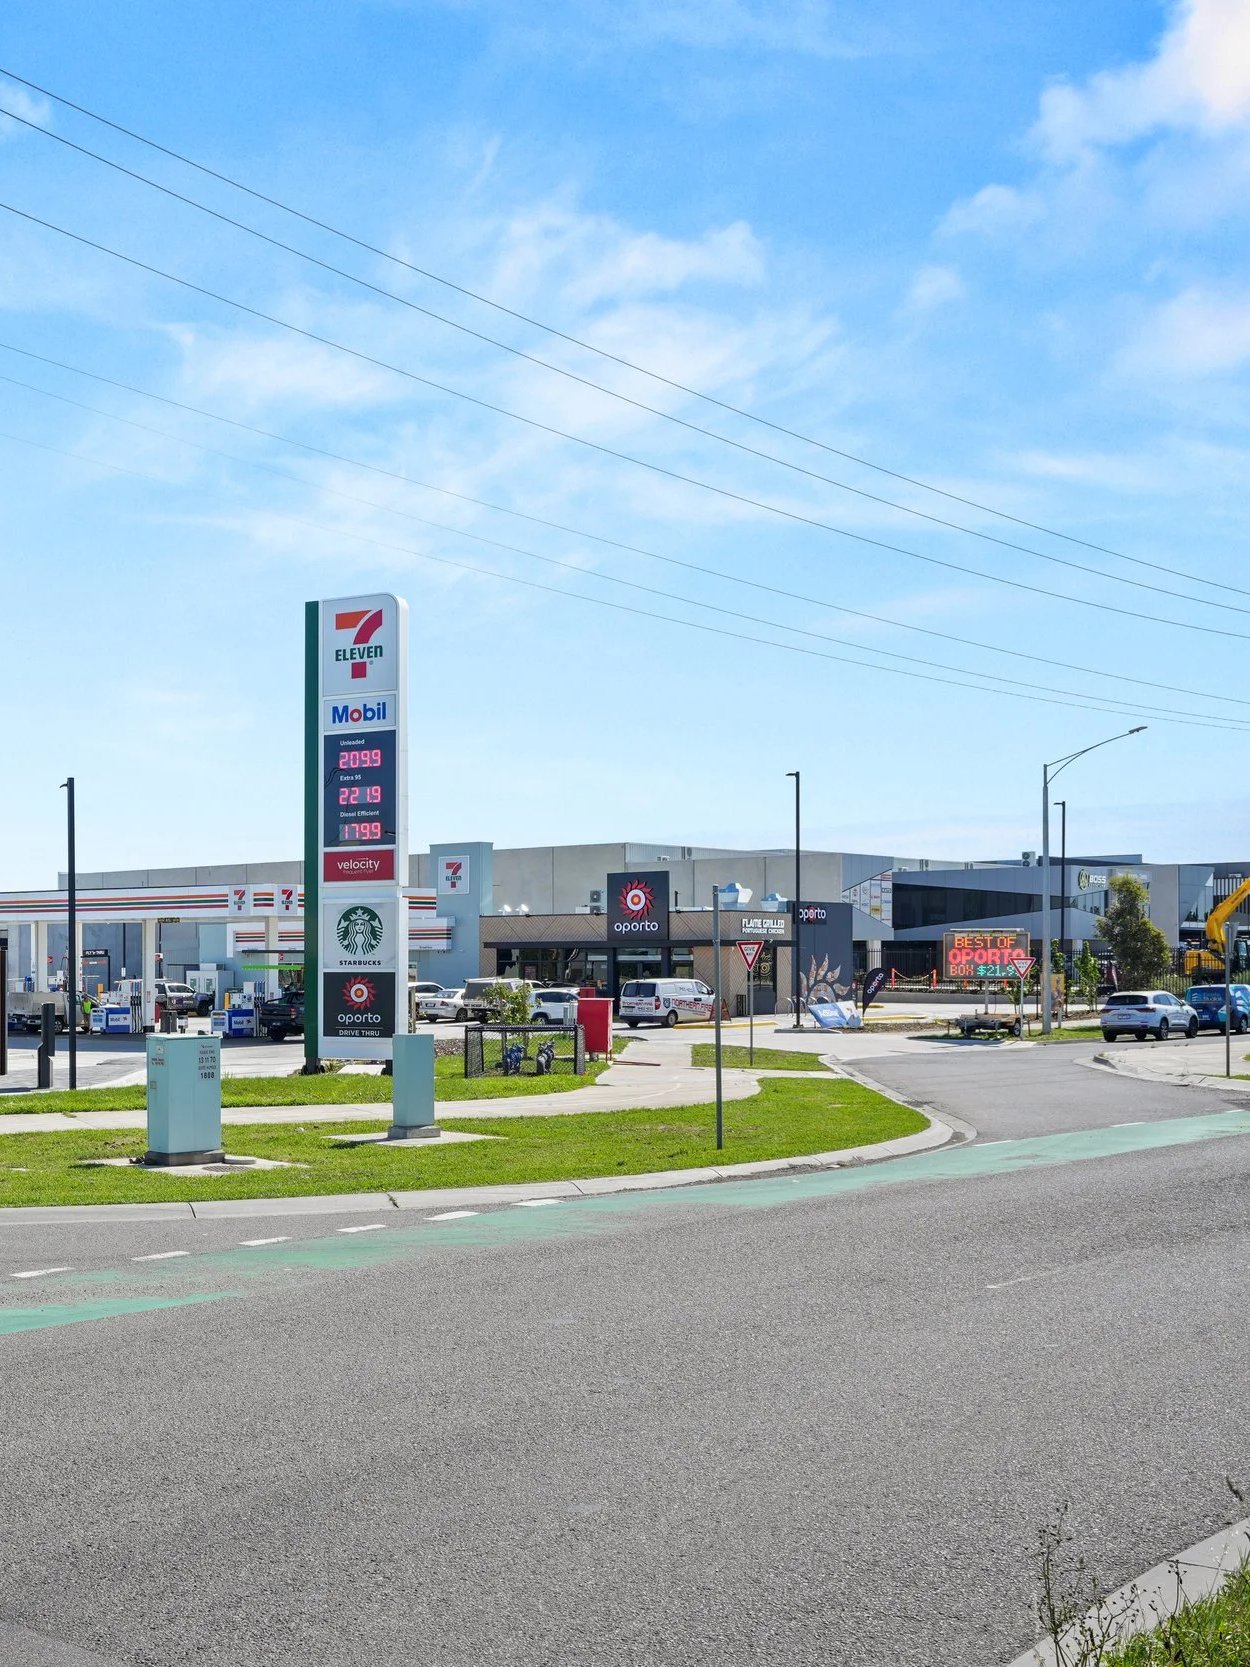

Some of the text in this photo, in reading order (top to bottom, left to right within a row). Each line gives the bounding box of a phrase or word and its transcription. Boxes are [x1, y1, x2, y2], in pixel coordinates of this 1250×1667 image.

[332, 702, 386, 724] Mobil
[339, 750, 381, 769] 209.9
[339, 786, 381, 805] 221.9
[344, 822, 381, 840] 179.9
[337, 859, 380, 871] velocity
[1089, 874, 1107, 884] BOSS
[614, 920, 659, 934] oporto
[742, 918, 785, 928] FLAME GRILLED
[954, 936, 1017, 948] BEST OF
[949, 964, 974, 976] BOX
[867, 972, 884, 994] oporto
[701, 1003, 712, 1012] FIRE
[338, 1012, 381, 1025] oporto
